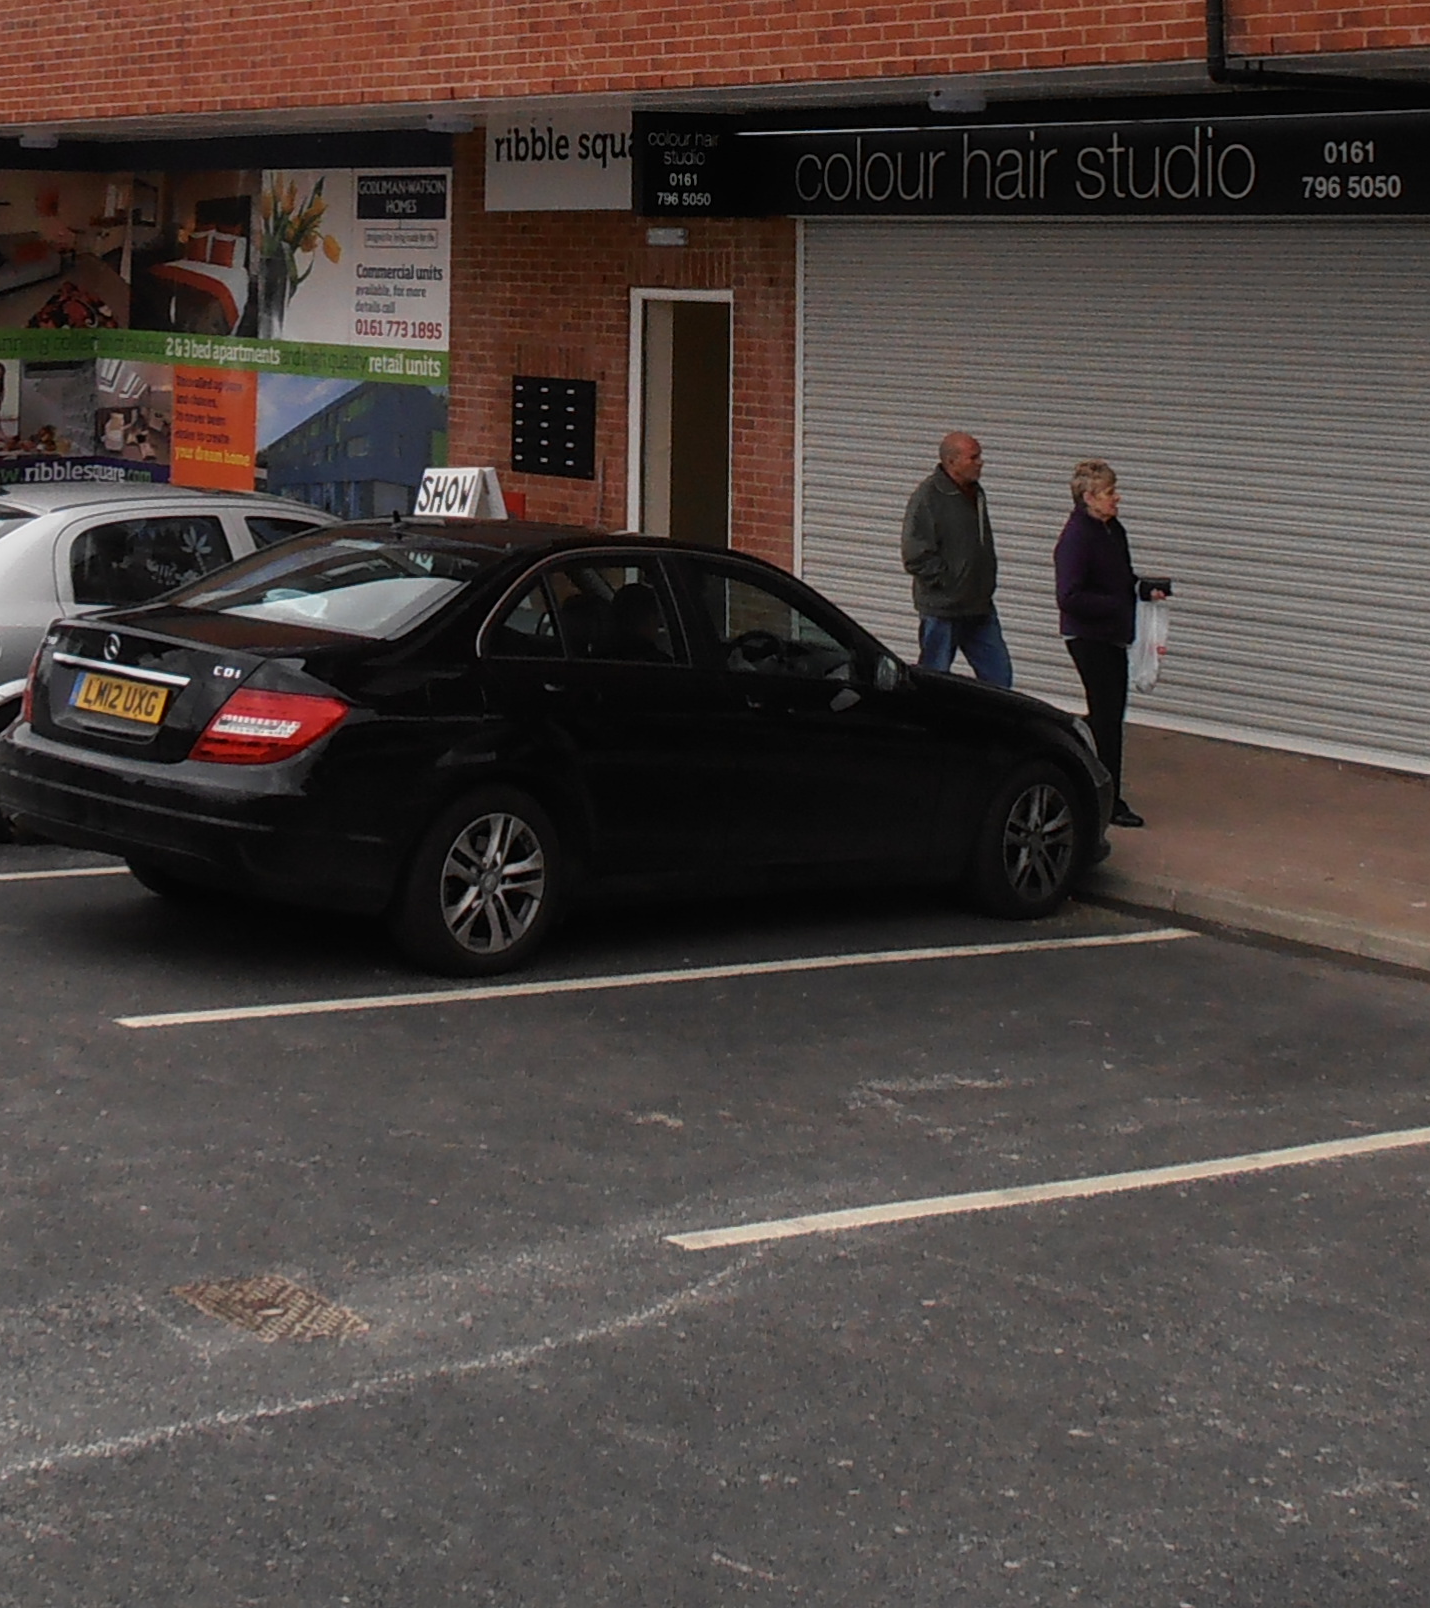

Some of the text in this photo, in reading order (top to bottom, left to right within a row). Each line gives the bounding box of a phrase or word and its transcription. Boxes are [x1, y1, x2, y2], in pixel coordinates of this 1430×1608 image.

[494, 126, 569, 162] ribble
[648, 131, 719, 148] colour hair
[663, 149, 706, 166] studio
[1323, 140, 1375, 164] 0161
[795, 126, 1256, 201] colour hair studio
[669, 172, 698, 186] 0161
[1301, 175, 1401, 199] 796 5050
[386, 199, 417, 213] HOMES
[682, 192, 711, 206] 5050
[356, 263, 443, 281] Commercial units
[393, 285, 404, 296] for
[355, 319, 443, 339] 0161 773 1895
[165, 337, 174, 356] 2
[184, 341, 191, 358] 3
[191, 340, 212, 360] bed
[212, 344, 280, 365] apartments
[368, 352, 441, 377] retail units
[175, 446, 251, 467] your dream home
[418, 475, 475, 513] SHOW
[83, 678, 159, 717] LM12 UXG
